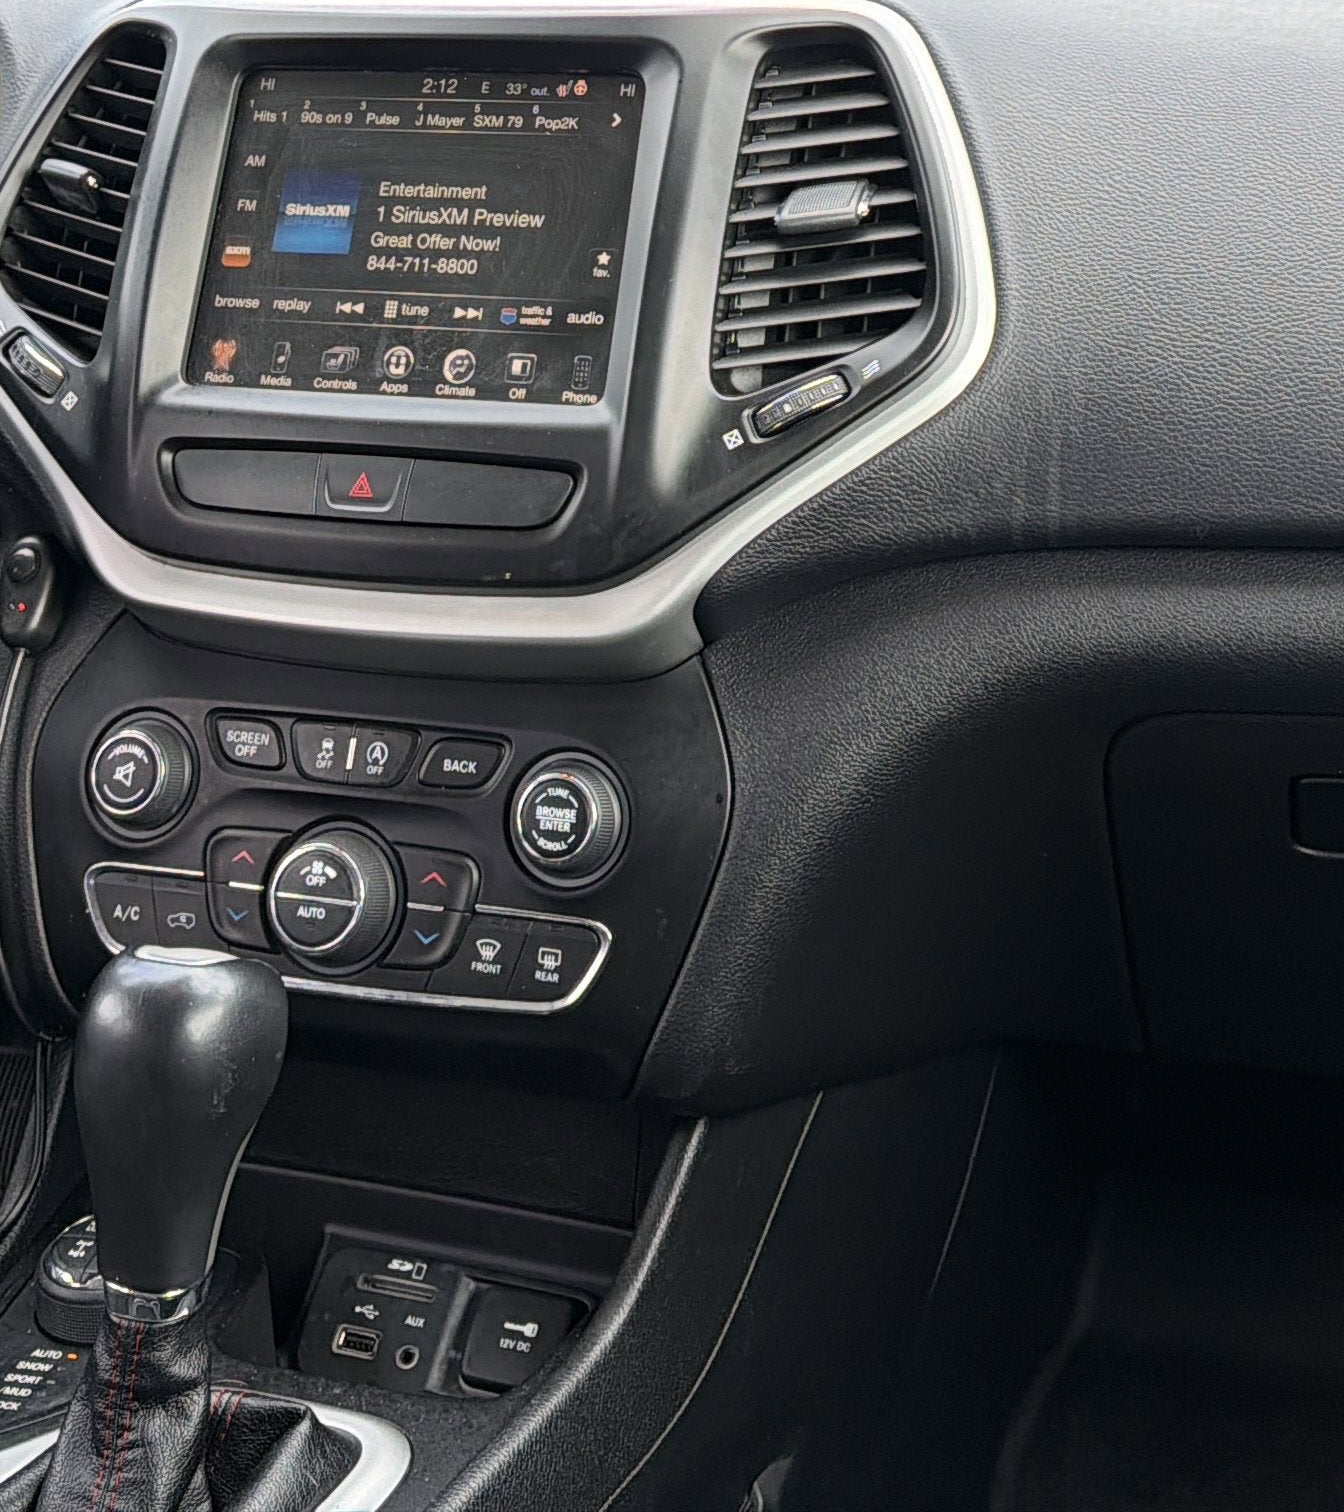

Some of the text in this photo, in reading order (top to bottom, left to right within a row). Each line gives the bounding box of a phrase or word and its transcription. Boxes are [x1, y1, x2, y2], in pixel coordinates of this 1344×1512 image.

[422, 78, 458, 94] 2:12
[481, 81, 491, 94] E
[619, 83, 636, 97] HI
[253, 110, 277, 123] Hits
[300, 112, 353, 124] 90s on 9
[365, 112, 400, 126] Pulse
[426, 114, 465, 130] Mayer
[472, 115, 523, 128] SXM 79
[535, 116, 579, 131] Pop2K
[244, 155, 266, 168] AM
[378, 181, 487, 200] Entertainment
[236, 199, 257, 212] FM
[284, 203, 351, 218] SiriusXM
[376, 206, 546, 229] 1 SiriusXM Preview
[370, 231, 501, 252] Great Offer Now!
[367, 255, 478, 275] 844-711-8800
[214, 294, 260, 309] browse
[273, 297, 311, 313] replay
[401, 303, 429, 317] tune
[566, 311, 605, 325] audio
[205, 371, 235, 384] Radio
[260, 374, 292, 387] Media
[313, 377, 358, 391] Controls
[379, 381, 409, 395] Apps
[435, 384, 477, 398] Climate
[508, 388, 528, 400] Off
[562, 390, 598, 405] Phone
[226, 729, 270, 746] SCREEN
[235, 744, 258, 758] OFF
[315, 760, 333, 770] OFF
[366, 765, 385, 776] OFF
[443, 759, 478, 774] BACK
[547, 787, 570, 799] TUNE
[536, 805, 577, 819] BROWSE
[539, 819, 571, 833] ENTER
[537, 836, 568, 851] SCROLL
[305, 875, 326, 887] OFF
[113, 903, 140, 923] A/C
[297, 905, 326, 919] AUTO
[471, 960, 503, 975] FRONT
[534, 970, 560, 983] REAR
[405, 1315, 426, 1328] AUX
[499, 1338, 531, 1352] 12V DC
[30, 1348, 63, 1359] AUTO
[16, 1361, 54, 1372] SNOW
[4, 1373, 44, 1385] SPORT
